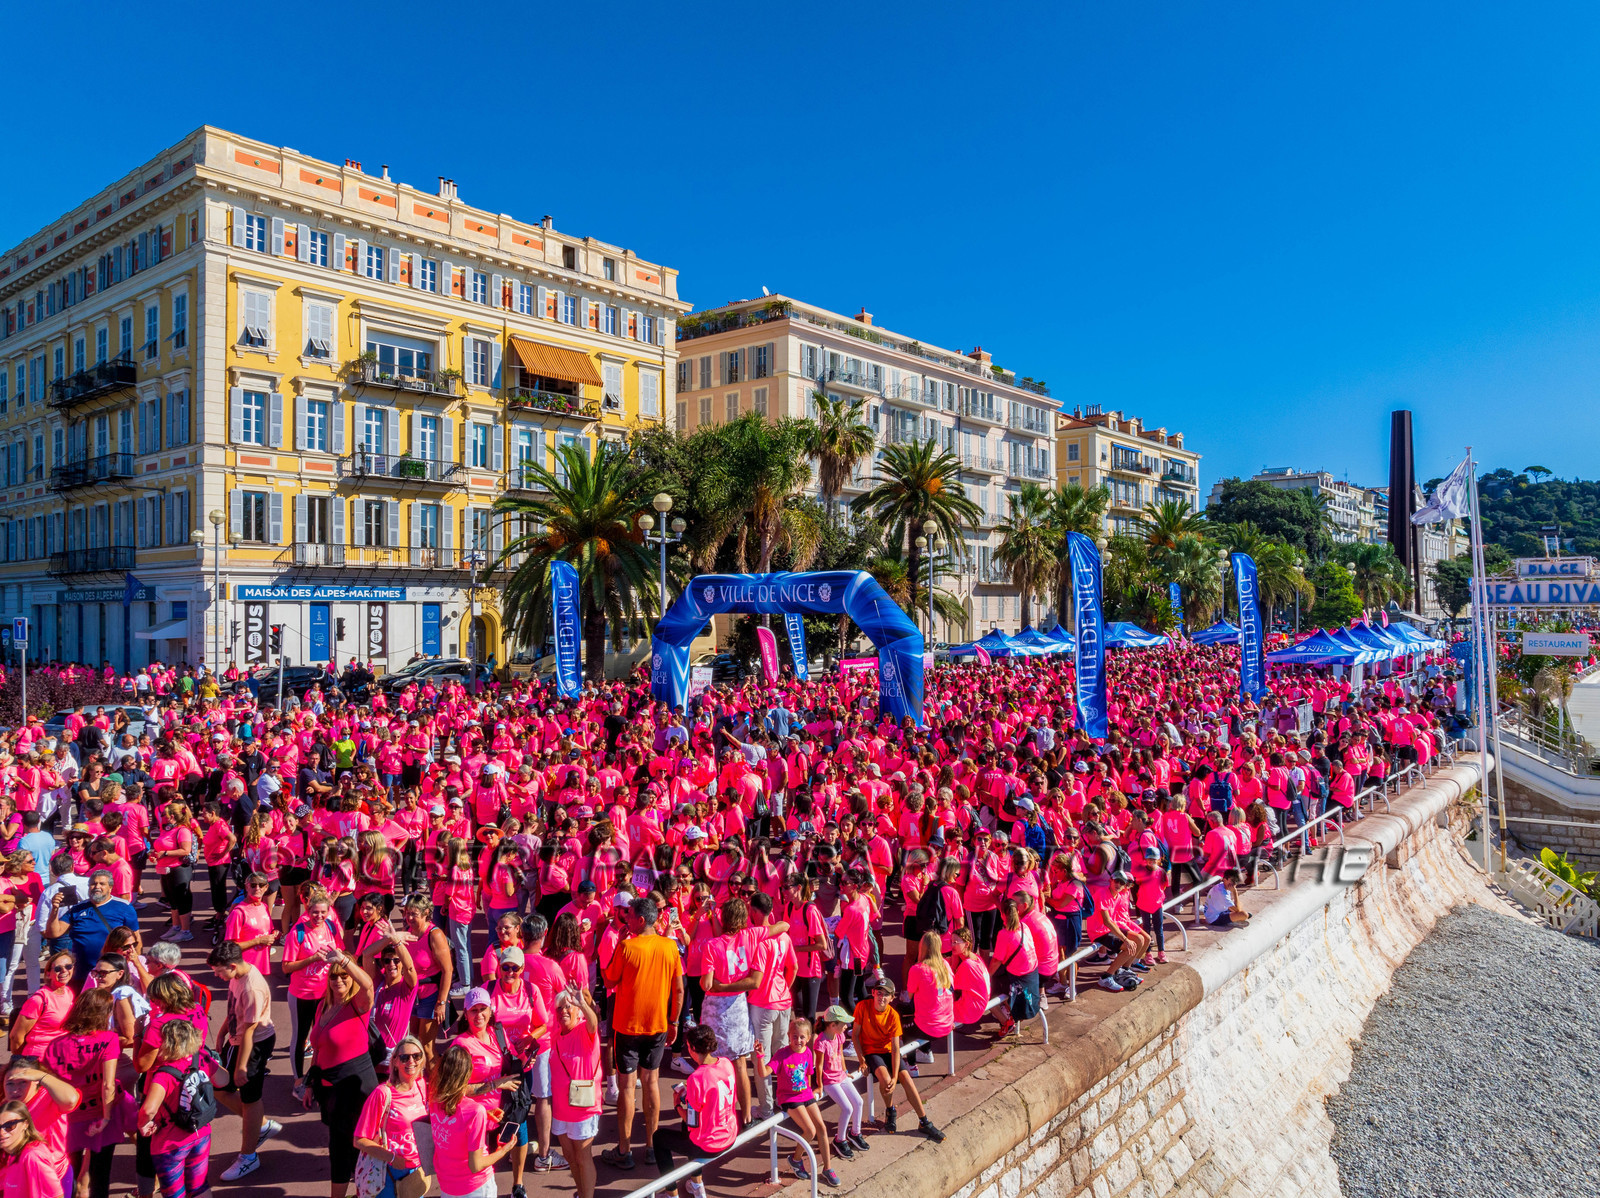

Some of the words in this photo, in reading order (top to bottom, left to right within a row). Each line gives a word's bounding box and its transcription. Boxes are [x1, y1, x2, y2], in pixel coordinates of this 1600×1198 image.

[1528, 563, 1578, 574] PLAGE
[64, 592, 84, 600] MAISON
[85, 591, 96, 600] DES
[96, 589, 146, 599] ALPES-MAMES
[245, 588, 288, 597] MAISON
[291, 588, 311, 597] DES
[313, 588, 401, 598] ALPES-MARITIMES
[558, 581, 573, 615] NICE
[719, 585, 755, 603] VILLE
[758, 584, 777, 603] DE
[780, 583, 816, 602] NICE
[1077, 563, 1096, 613] NICE
[1240, 574, 1254, 611] NICE
[1480, 584, 1541, 603] BEAU
[247, 604, 264, 661] VOUS
[369, 604, 384, 657] VOUS
[559, 619, 575, 637] DE
[788, 615, 800, 632] DE
[1080, 617, 1098, 645] DE
[1243, 614, 1256, 635] DE
[791, 633, 804, 663] VILLE
[1528, 640, 1583, 649] RESTAURANT
[560, 640, 576, 677] VILLE
[1246, 639, 1259, 678] VILLE
[1079, 649, 1098, 703] VILLE
[606, 776, 616, 789] N
[630, 824, 640, 841] N
[1167, 818, 1179, 833] N
[305, 962, 331, 976] ROS
[726, 945, 748, 975] N
[77, 1041, 109, 1054] TEAM
[717, 1074, 736, 1111] N
